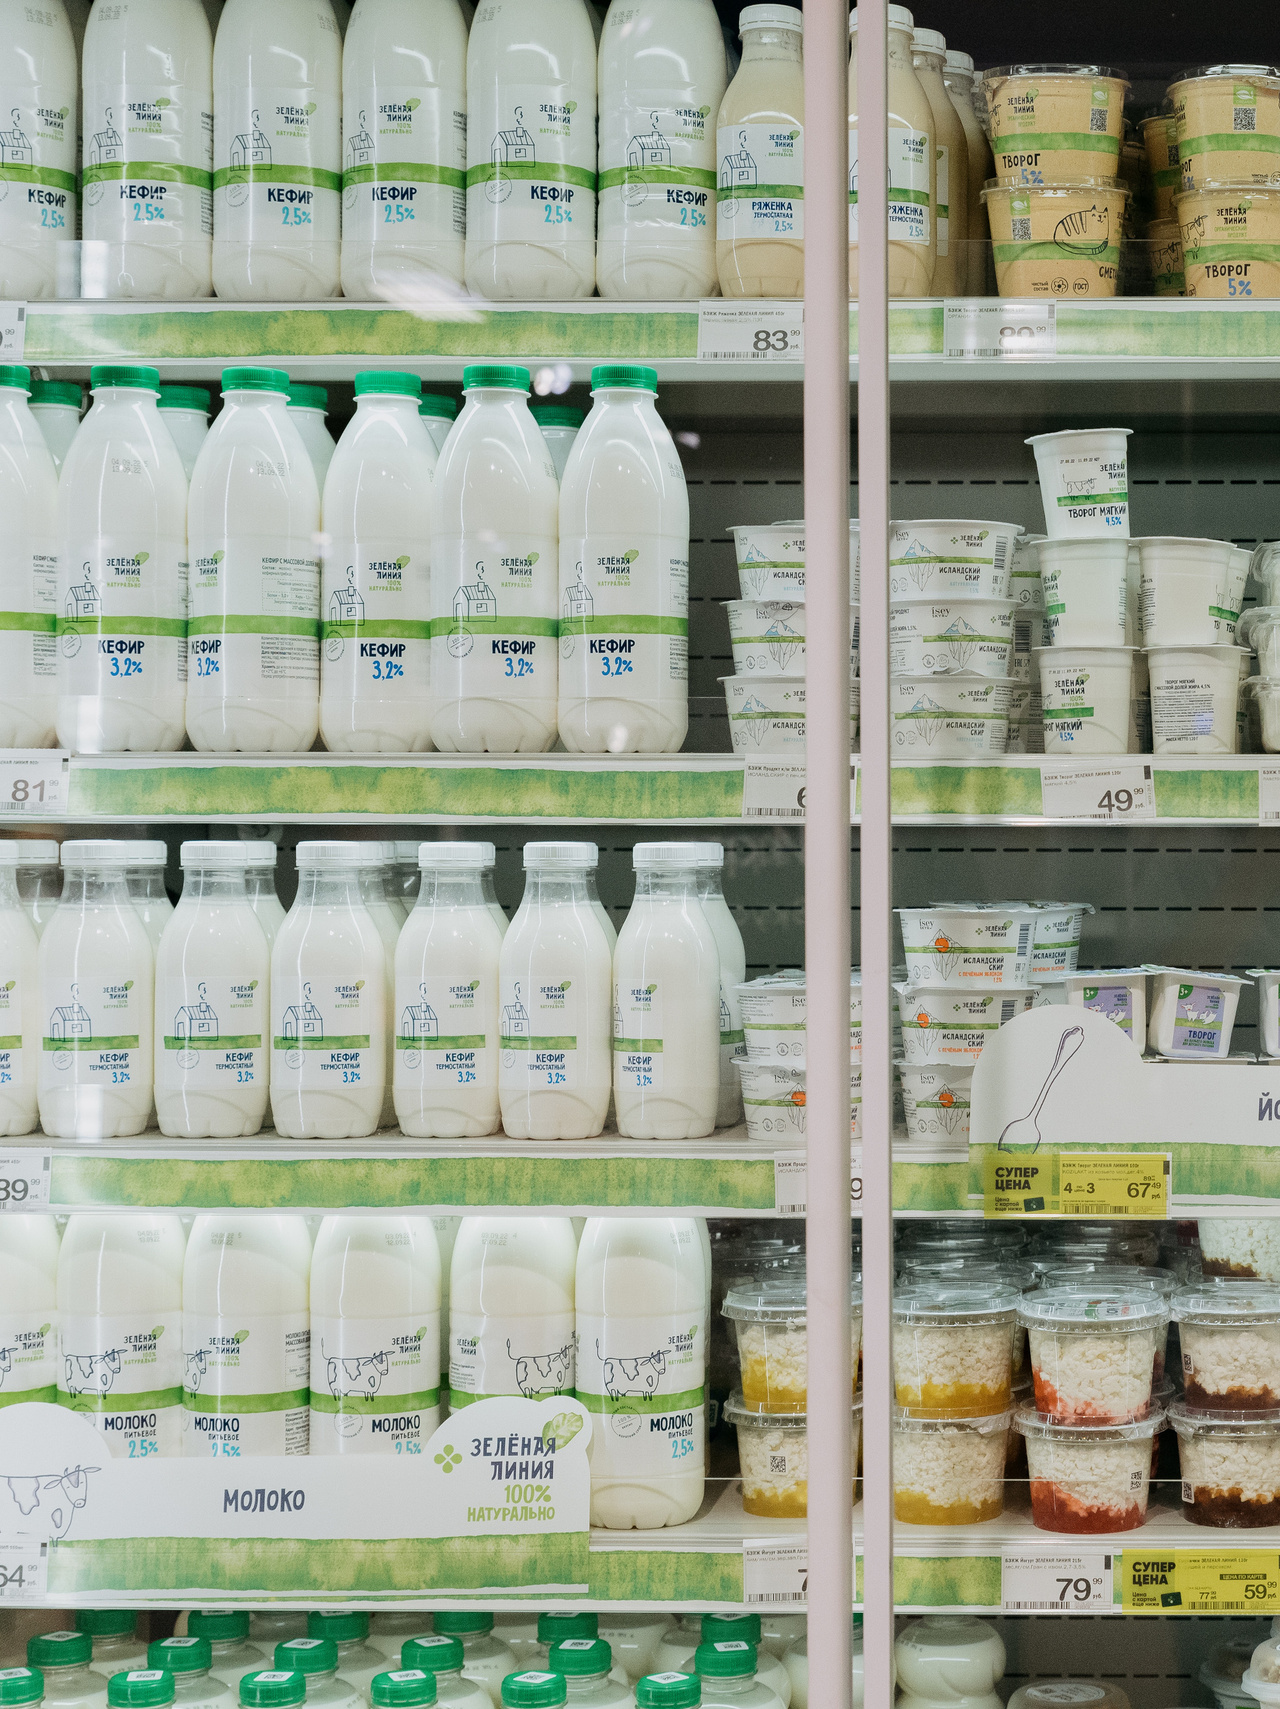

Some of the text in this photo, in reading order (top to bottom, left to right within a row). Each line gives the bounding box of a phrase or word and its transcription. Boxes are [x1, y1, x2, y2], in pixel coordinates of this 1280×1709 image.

[28, 189, 67, 208] КЕФИР
[752, 201, 793, 211] РЯЖЕНКА
[282, 206, 312, 225] 2,5%
[384, 204, 415, 222] 2,5%
[544, 204, 572, 223] 2,5%
[888, 205, 923, 217] РЯЖЕНКА
[1205, 264, 1251, 277] ТВОРОГ
[1228, 278, 1252, 295] 5%
[753, 330, 789, 351] 83
[1105, 516, 1122, 527] 4,5%
[939, 567, 981, 575] ИСЛАНДСКИЙ
[98, 640, 145, 654] КЕФИР
[492, 640, 536, 655] КЕФИР
[590, 639, 635, 653] КЕФИР
[110, 658, 143, 677] 3,2%
[372, 660, 404, 680] 3,2%
[504, 658, 534, 677] 3,2%
[11, 779, 45, 802] 81
[1098, 789, 1133, 812] 49
[230, 985, 253, 993] ЗЕЛЁНАЯ
[100, 1054, 129, 1064] КЕФИР
[445, 1053, 475, 1063] КЕФИР
[112, 1072, 130, 1083] 3,2%
[458, 1071, 476, 1083] 3,2%
[995, 1167, 1039, 1178] СУПЕР
[995, 1179, 1031, 1191] ЦЕНА
[1064, 1183, 1095, 1193] 4 3
[1127, 1182, 1151, 1198] 67
[132, 1343, 157, 1353] ЛИНИЯ
[676, 1342, 693, 1352] ЛИНИЯ
[104, 1413, 157, 1431] МОЛОКО
[650, 1413, 693, 1433] МОЛОКО
[124, 1430, 157, 1438] ПИТЬЕВОЕ
[391, 1431, 421, 1440] ПИТЬЕВОЕ
[668, 1428, 693, 1438] ПИТЬЕВОЕ
[470, 1433, 556, 1457] ЗЕЛЁНАЯ
[672, 1439, 694, 1459] 2,5%
[491, 1461, 554, 1480] ЛИНИЯ
[224, 1489, 305, 1512] МОЛОКО
[504, 1484, 552, 1504] 100%
[467, 1506, 555, 1522] НАТУРАЛЬНО
[1132, 1574, 1168, 1586] ЦЕНА
[1056, 1578, 1091, 1601] 79
[1243, 1584, 1268, 1599] 59
